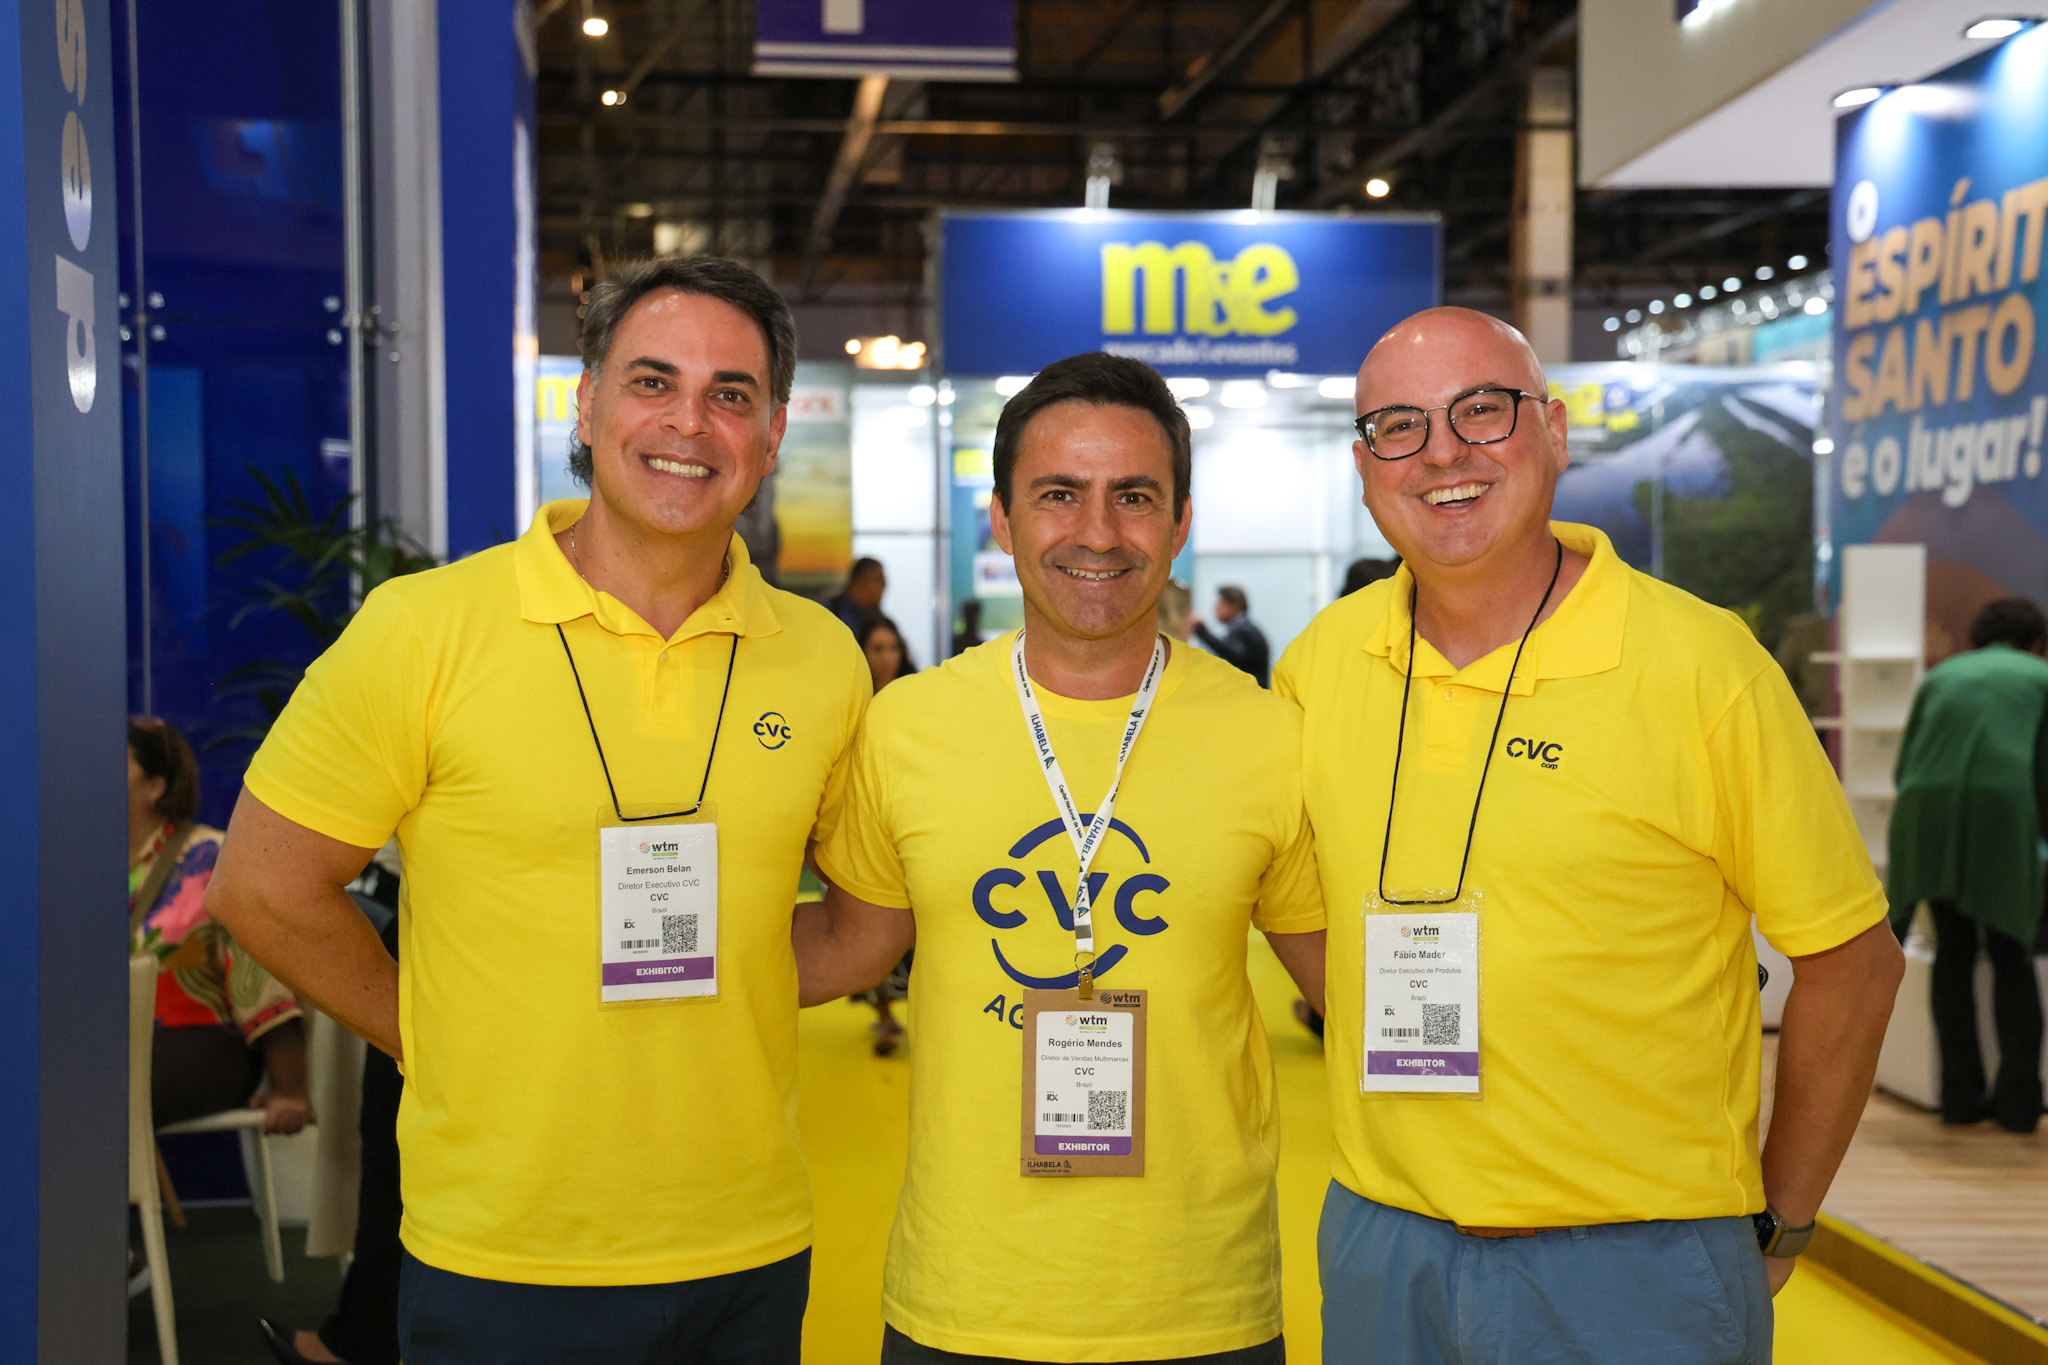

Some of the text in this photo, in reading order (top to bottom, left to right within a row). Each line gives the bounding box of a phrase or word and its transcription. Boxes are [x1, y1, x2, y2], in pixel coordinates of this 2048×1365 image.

[1847, 179, 1879, 243] O
[1843, 177, 2048, 330] ESPÍRIT
[1101, 240, 1299, 337] m&e
[1842, 293, 2035, 421] SANTO
[1842, 396, 2048, 508] é o lugar!
[753, 722, 792, 739] CVC
[1030, 713, 1049, 756] ILHABELA
[1507, 737, 1563, 762] CVC
[1058, 784, 1068, 801] Capital
[1065, 800, 1077, 821] Nacional
[652, 841, 678, 852] wtm
[626, 865, 691, 875] Emerson Belan
[618, 879, 699, 890] Diretor Executivo CVC
[650, 893, 669, 901] CVC
[972, 868, 1171, 936] CVC
[1413, 925, 1439, 936] wtm
[1394, 950, 1446, 959] Fábio Mader
[636, 966, 685, 976] EXHIBITOR
[1410, 980, 1428, 988] CVC
[1113, 993, 1140, 1003] wtm
[1079, 1015, 1107, 1025] wtm
[1048, 1038, 1122, 1050] Rogério Mendes
[1396, 1058, 1445, 1067] EXHIBITOR
[1075, 1067, 1095, 1075] CVC
[1058, 1143, 1110, 1151] EXHIBITOR
